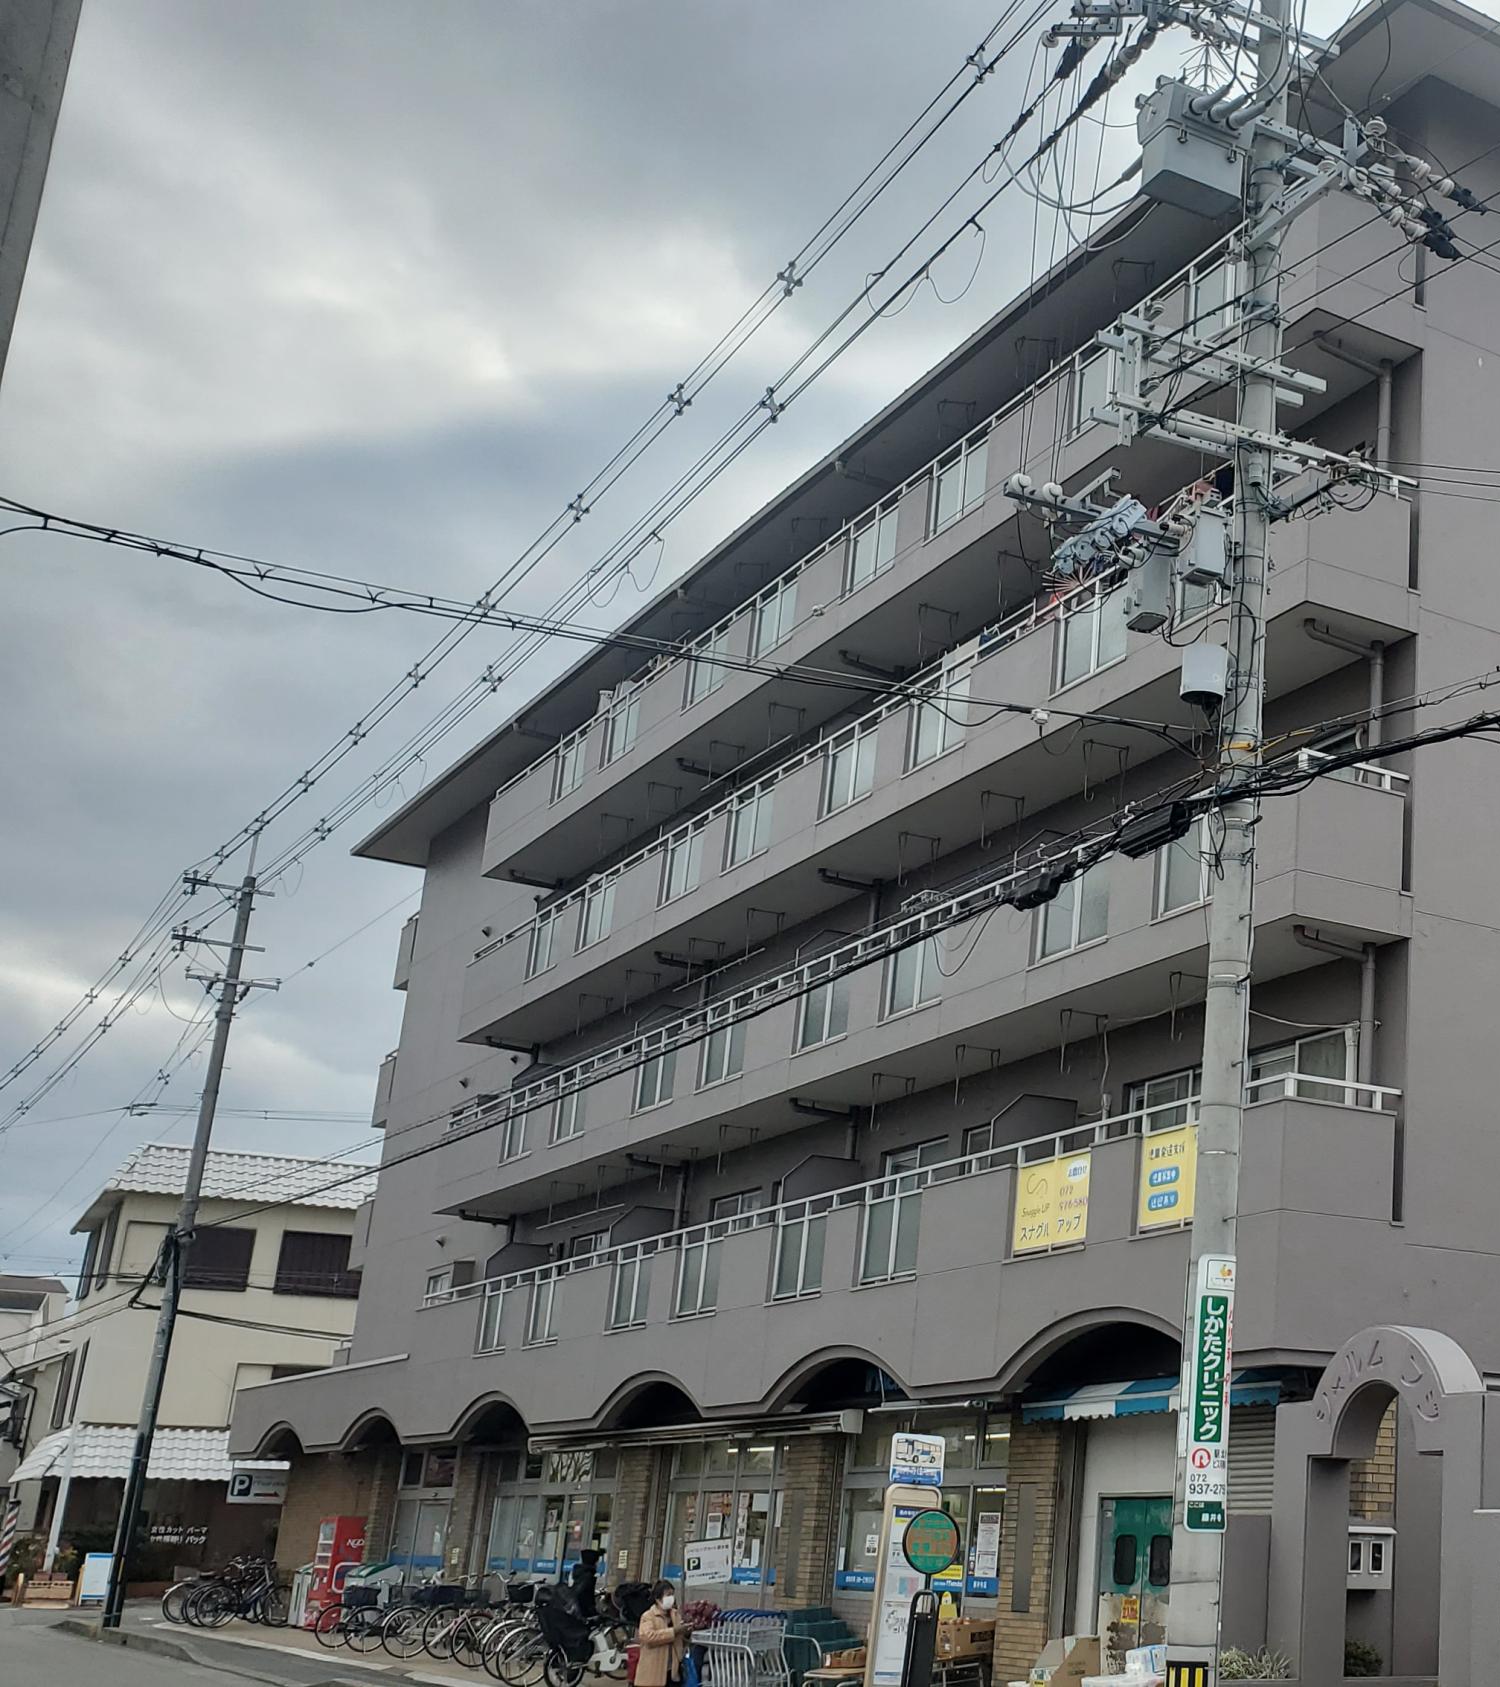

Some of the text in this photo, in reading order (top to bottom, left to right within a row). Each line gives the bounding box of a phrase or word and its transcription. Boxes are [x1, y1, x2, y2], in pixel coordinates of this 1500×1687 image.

[1199, 1297, 1224, 1441] しかたクリニック
[1190, 1473, 1207, 1482] 072
